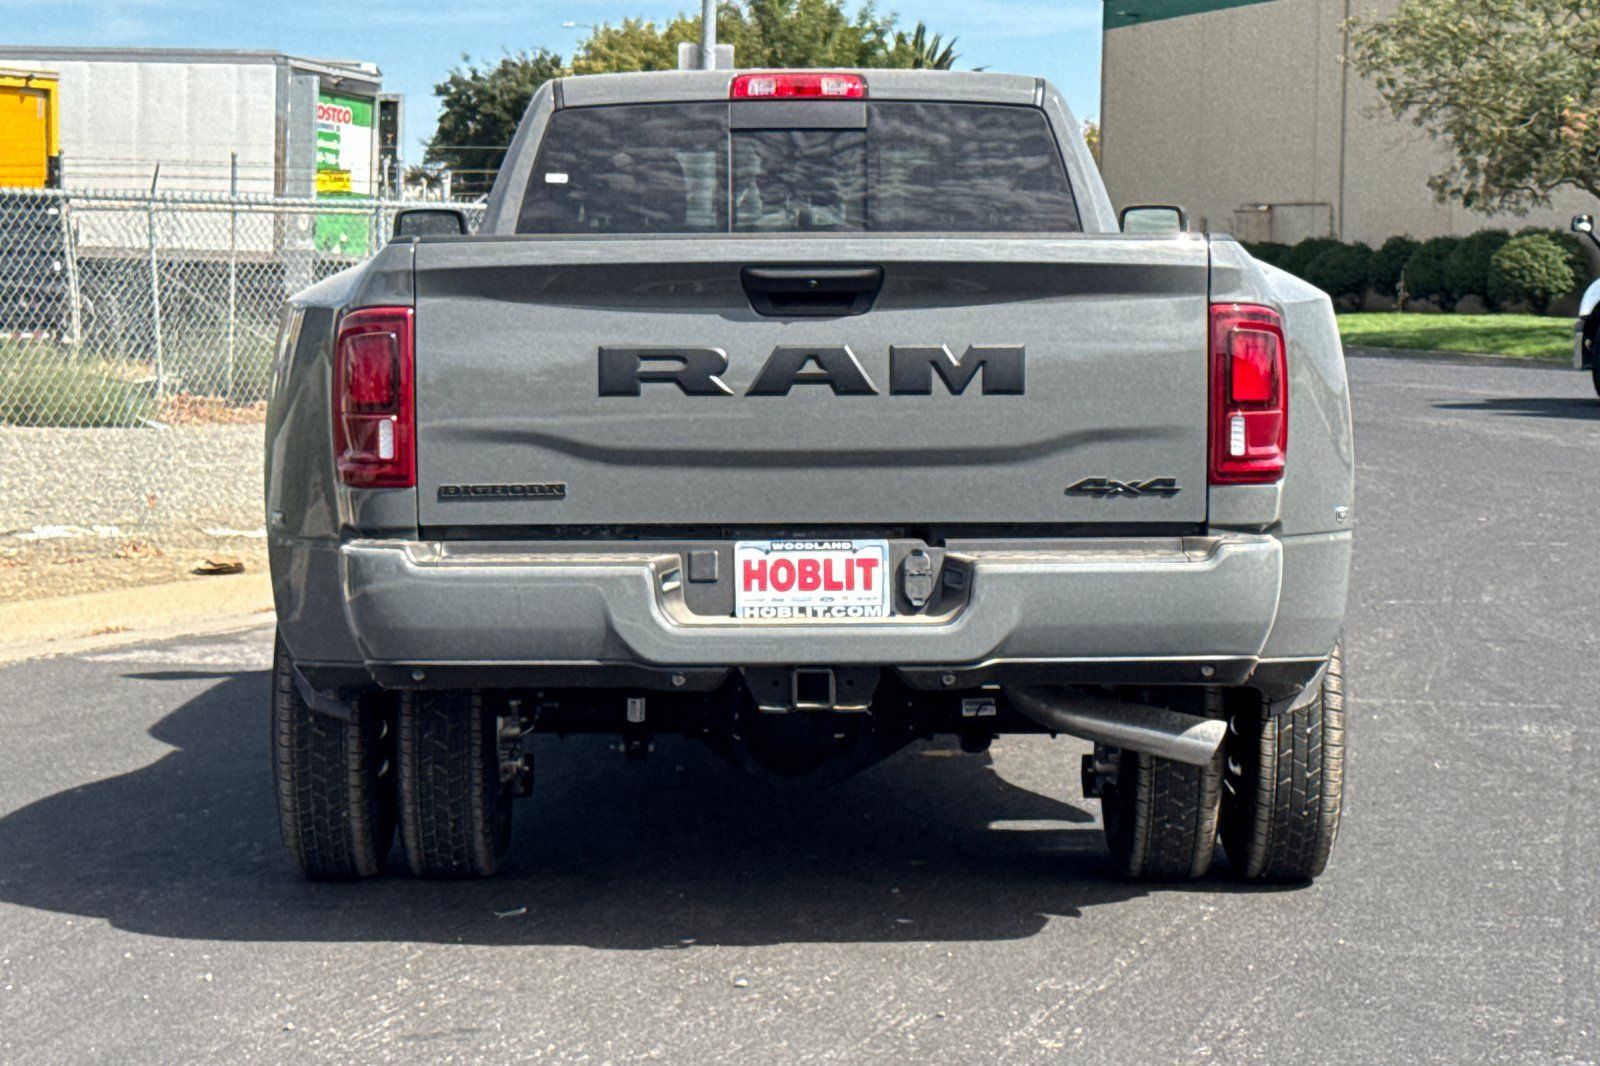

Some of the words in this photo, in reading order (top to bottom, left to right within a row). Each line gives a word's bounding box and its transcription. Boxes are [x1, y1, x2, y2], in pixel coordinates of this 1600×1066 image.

[317, 104, 352, 124] OSTCO
[598, 344, 1025, 397] RAM
[771, 541, 853, 551] WOODLAND
[743, 558, 879, 593] HOBLIT
[743, 605, 882, 618] HOBLIT.COM
